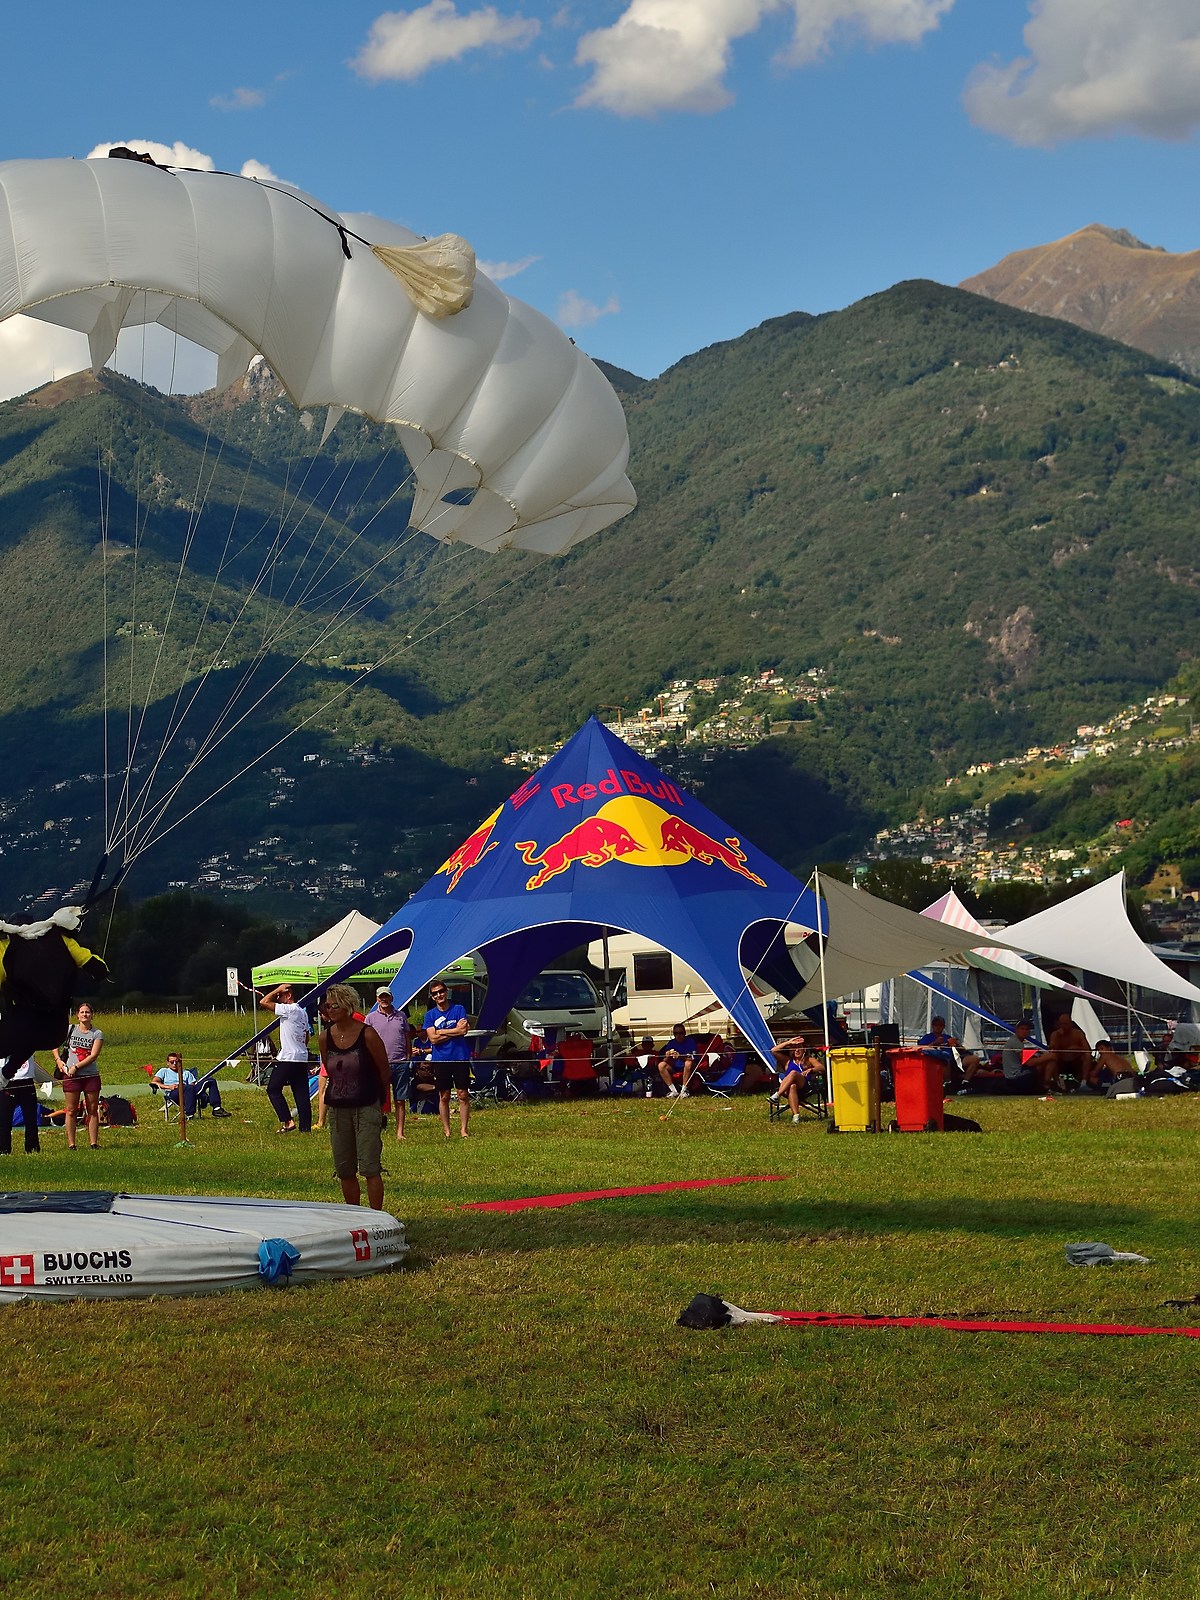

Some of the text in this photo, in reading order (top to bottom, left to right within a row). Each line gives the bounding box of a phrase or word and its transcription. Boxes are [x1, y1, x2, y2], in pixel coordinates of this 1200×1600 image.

[550, 769, 684, 809] Red Bull
[43, 1249, 132, 1272] BUOCHS
[44, 1273, 133, 1286] SWITZERLAND
